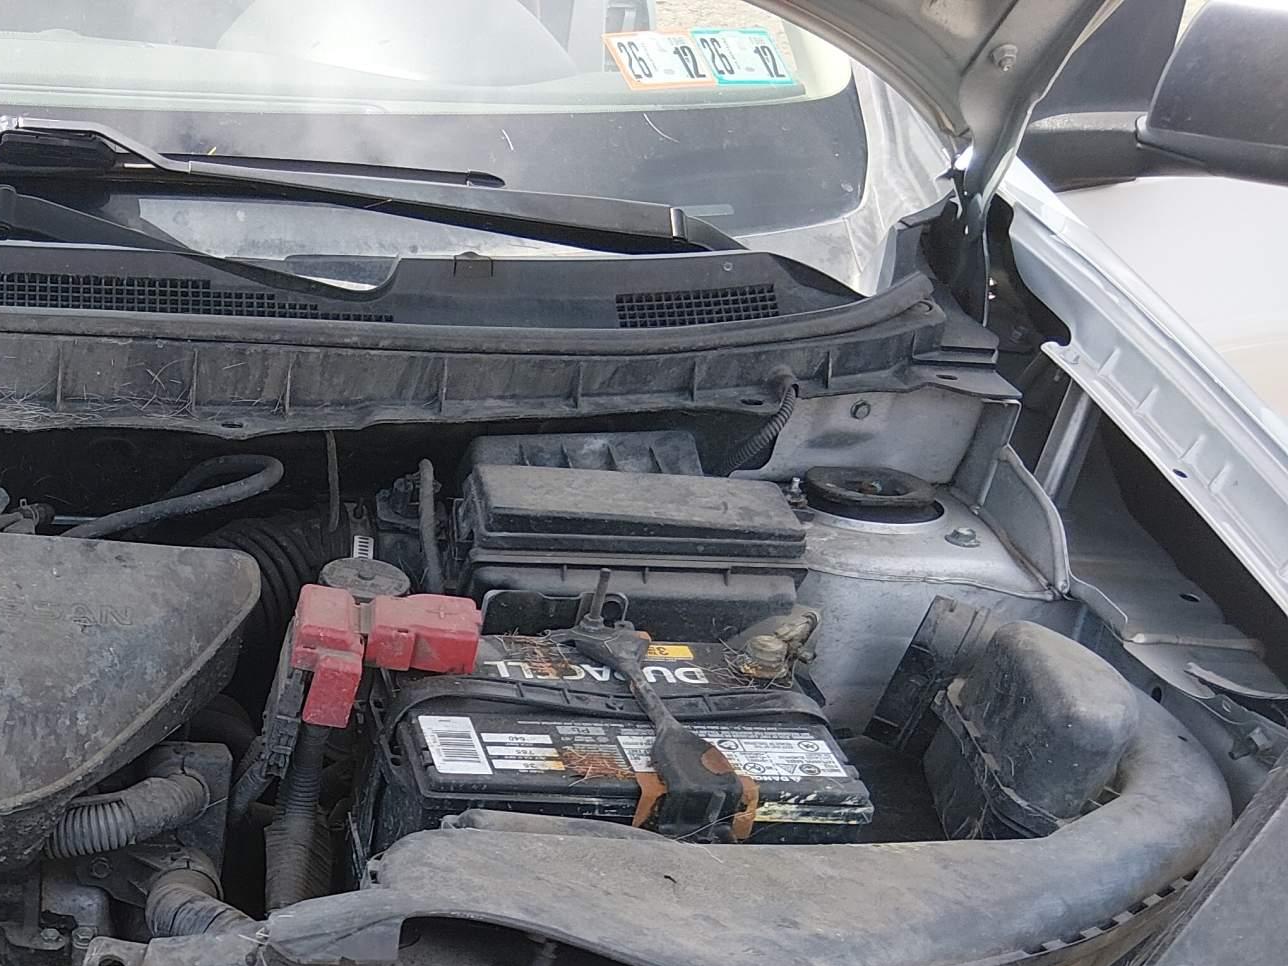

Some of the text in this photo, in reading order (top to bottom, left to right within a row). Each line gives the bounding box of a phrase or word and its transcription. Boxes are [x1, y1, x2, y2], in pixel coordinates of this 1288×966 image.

[617, 41, 653, 79] 26
[673, 45, 707, 79] 12
[699, 38, 735, 75] 26
[754, 45, 785, 78] 12
[483, 659, 709, 684] DUACLL
